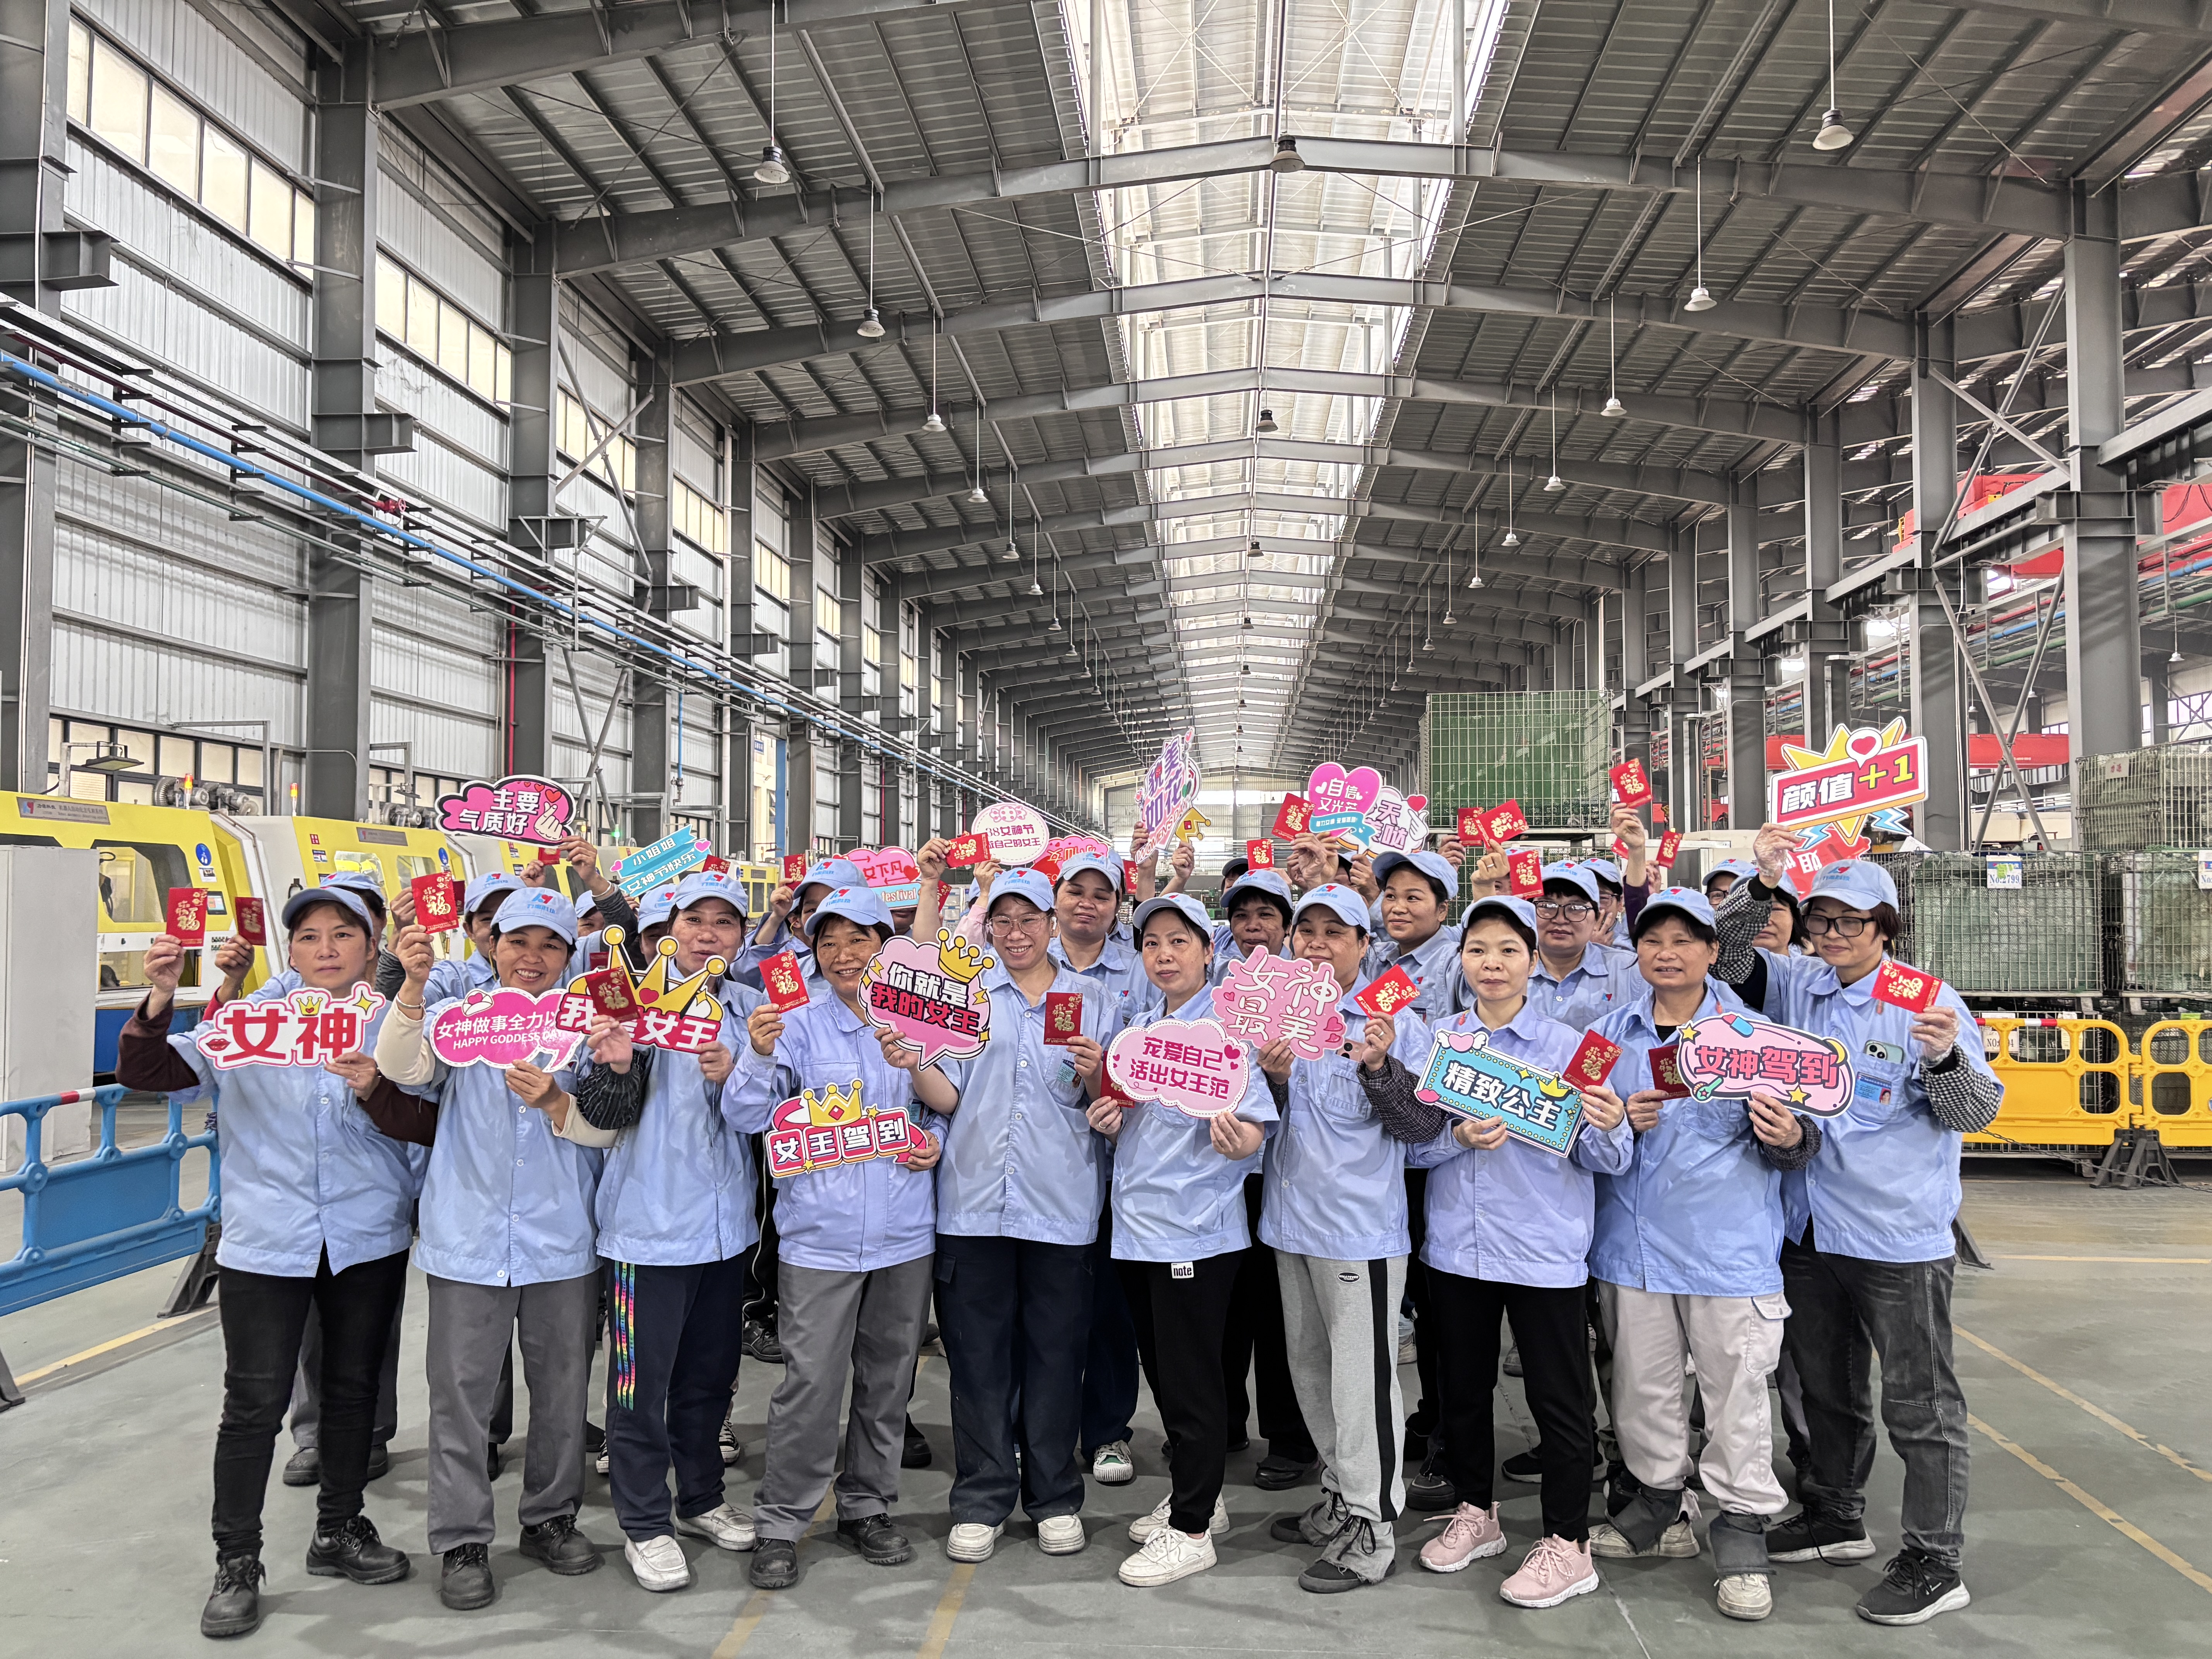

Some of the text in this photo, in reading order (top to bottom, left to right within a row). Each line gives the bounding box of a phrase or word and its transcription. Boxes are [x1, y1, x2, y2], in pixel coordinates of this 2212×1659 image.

[491, 789, 539, 814] 主要
[1146, 768, 1182, 832] 如花
[1327, 778, 1358, 799] 自信
[1781, 754, 1914, 814] 颜值+1
[459, 809, 527, 835] 气质好
[986, 824, 1034, 836] 38女神节
[1137, 819, 1173, 861] WOMEN'S
[627, 848, 696, 894] 女神节快乐
[633, 838, 676, 866] 小姐姐
[426, 891, 451, 915] 福
[881, 888, 917, 902] festival
[887, 962, 969, 1008] 你就是
[1235, 953, 1338, 1016] 女神
[872, 982, 979, 1037] 我的女王
[1055, 1010, 1075, 1031] 福
[1226, 997, 1320, 1053] 最美
[223, 1008, 356, 1064] 女神
[453, 1036, 488, 1050] HAPPY
[490, 1032, 540, 1044] GODDESS
[1143, 1036, 1223, 1072] 宠爱自己
[1129, 1058, 1230, 1101] 活出女王范
[1581, 1055, 1606, 1080] 福
[1696, 1046, 1839, 1087] 女神驾到
[1443, 1061, 1560, 1130] 精致公主
[773, 1118, 903, 1163] 女王驾到
[1173, 1266, 1192, 1276] note
